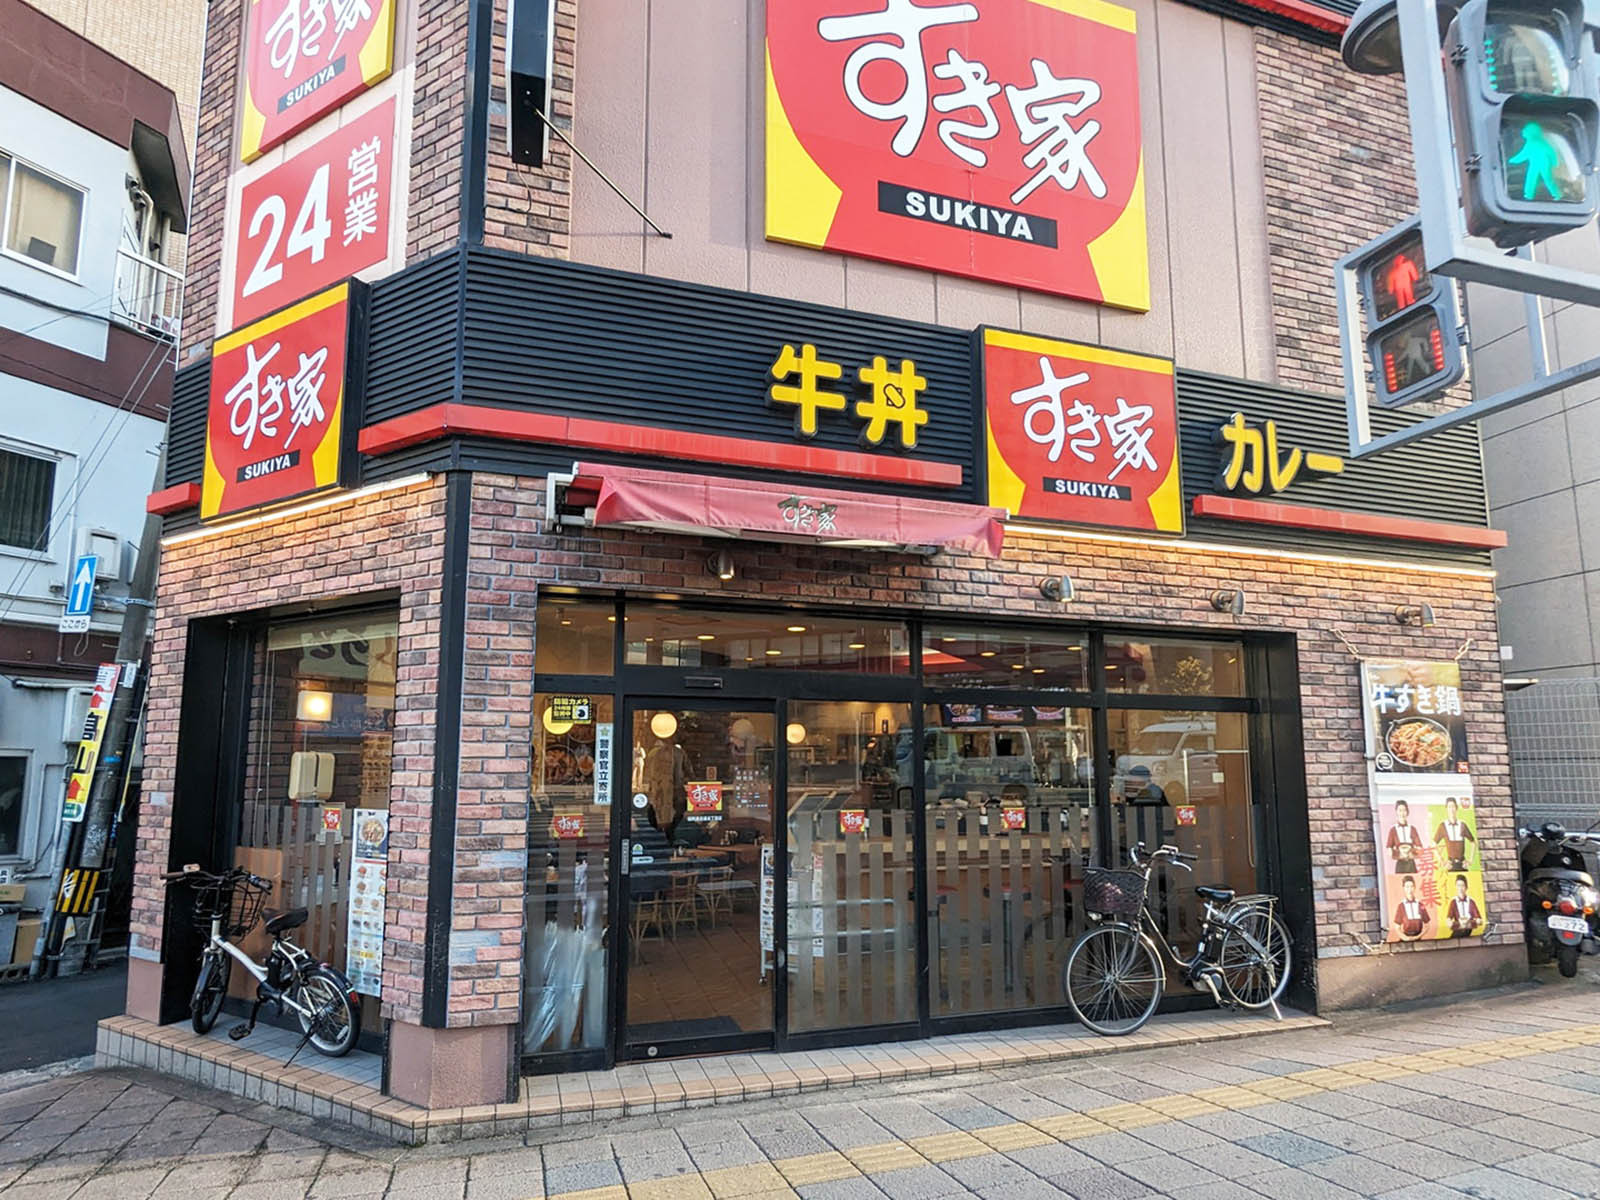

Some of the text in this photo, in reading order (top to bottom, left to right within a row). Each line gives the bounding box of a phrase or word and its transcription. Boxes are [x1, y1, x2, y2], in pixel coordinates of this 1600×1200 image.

[285, 63, 337, 107] SUKIYA
[818, 0, 1108, 205] すき家
[343, 136, 381, 247] 営業
[905, 190, 1034, 241] SUKIYA
[242, 163, 331, 298] 24
[224, 341, 329, 450] すき家
[770, 343, 929, 449] 牛丼
[1010, 356, 1158, 480] すき家
[244, 456, 292, 481] SUKIYA
[1222, 412, 1345, 491] カレー
[777, 494, 838, 534] すき家
[1054, 478, 1120, 500] SUKIYA
[1370, 683, 1461, 716] 牛すき鍋
[598, 738, 609, 802] 警察官立寄所
